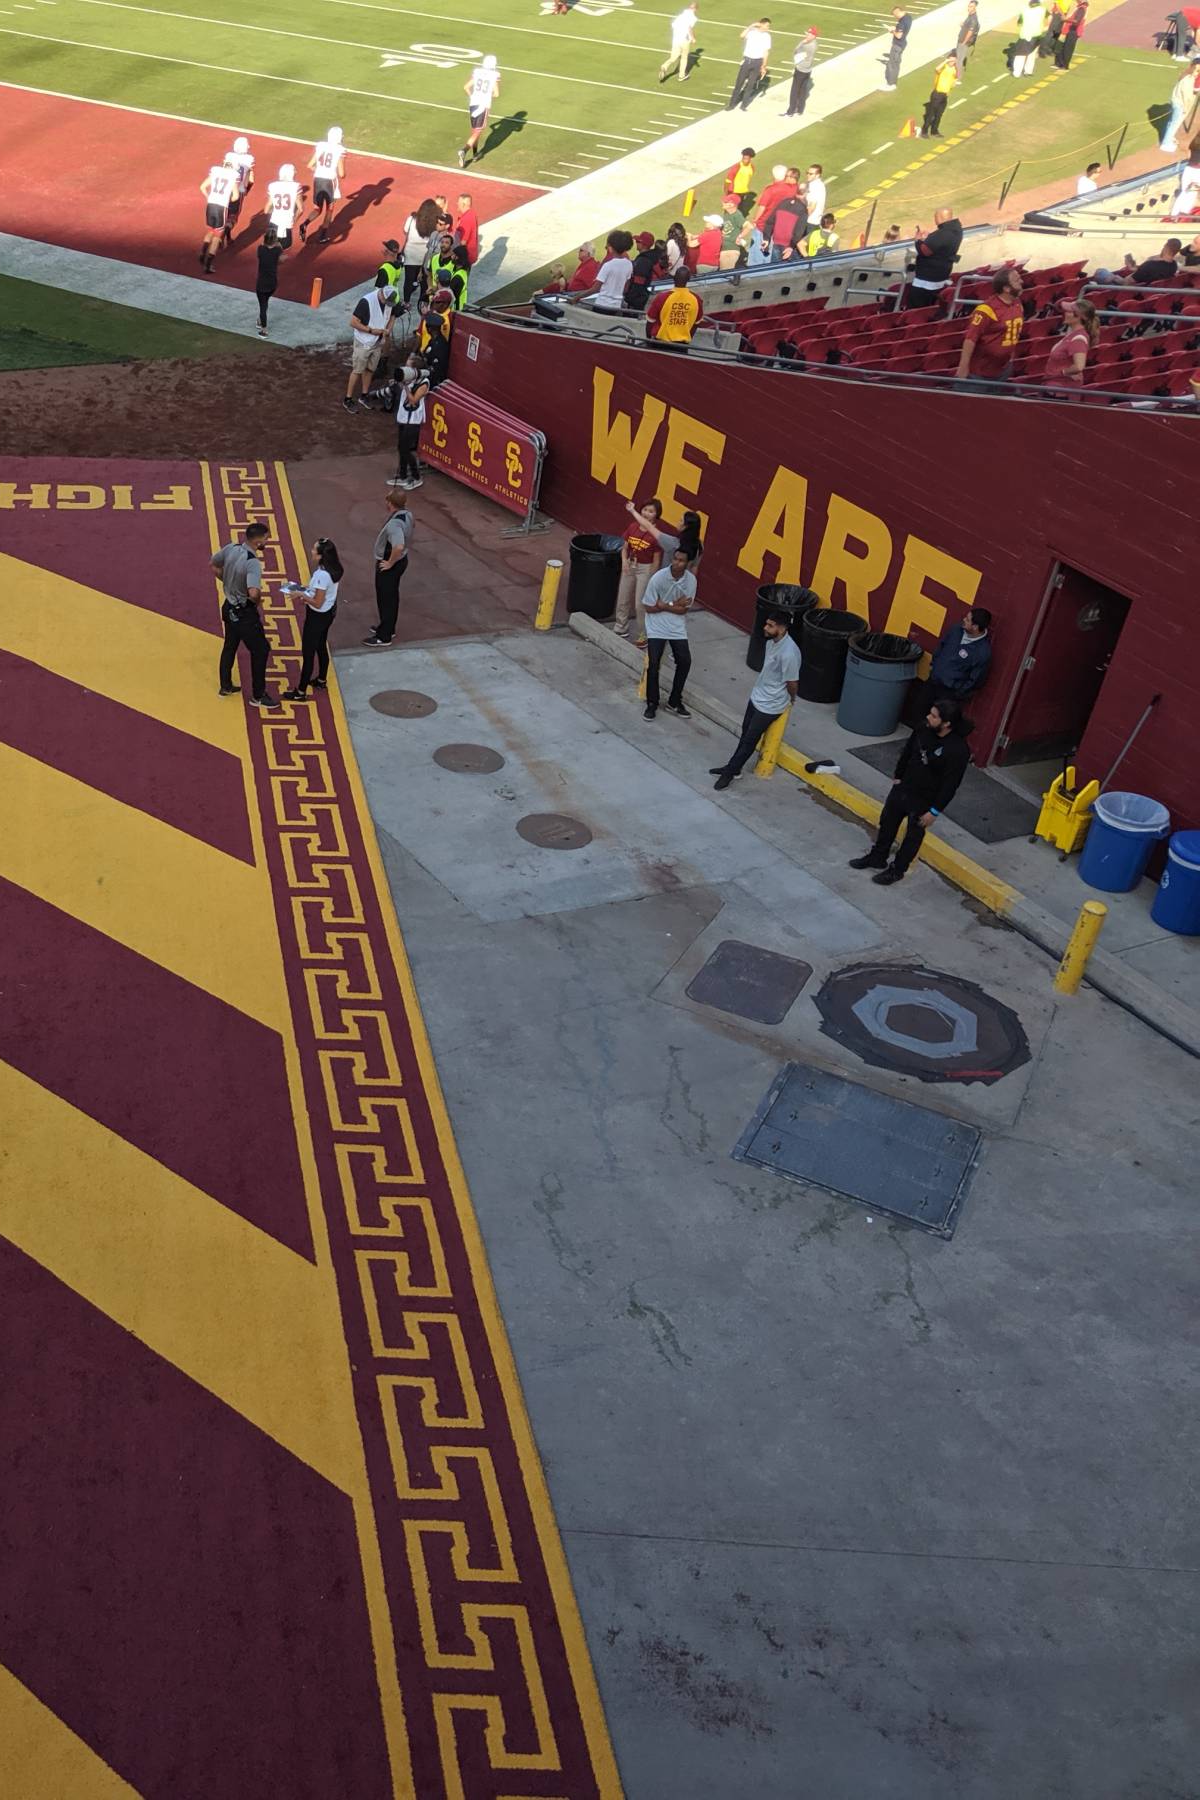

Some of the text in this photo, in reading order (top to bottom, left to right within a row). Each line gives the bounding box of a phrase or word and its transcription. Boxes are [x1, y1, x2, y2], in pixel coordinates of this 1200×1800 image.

[379, 43, 484, 68] 10
[475, 78, 489, 94] 93
[317, 151, 333, 168] 48
[212, 177, 229, 195] 17
[274, 193, 291, 210] 33
[672, 303, 691, 311] CSC
[432, 402, 448, 448] SC
[422, 443, 452, 465] ATHLETICS
[467, 421, 483, 468] SC
[457, 463, 488, 485] ATHLETICS
[505, 440, 523, 488] SC
[494, 483, 528, 506] ATHLETICS
[591, 366, 983, 681] WE ARE
